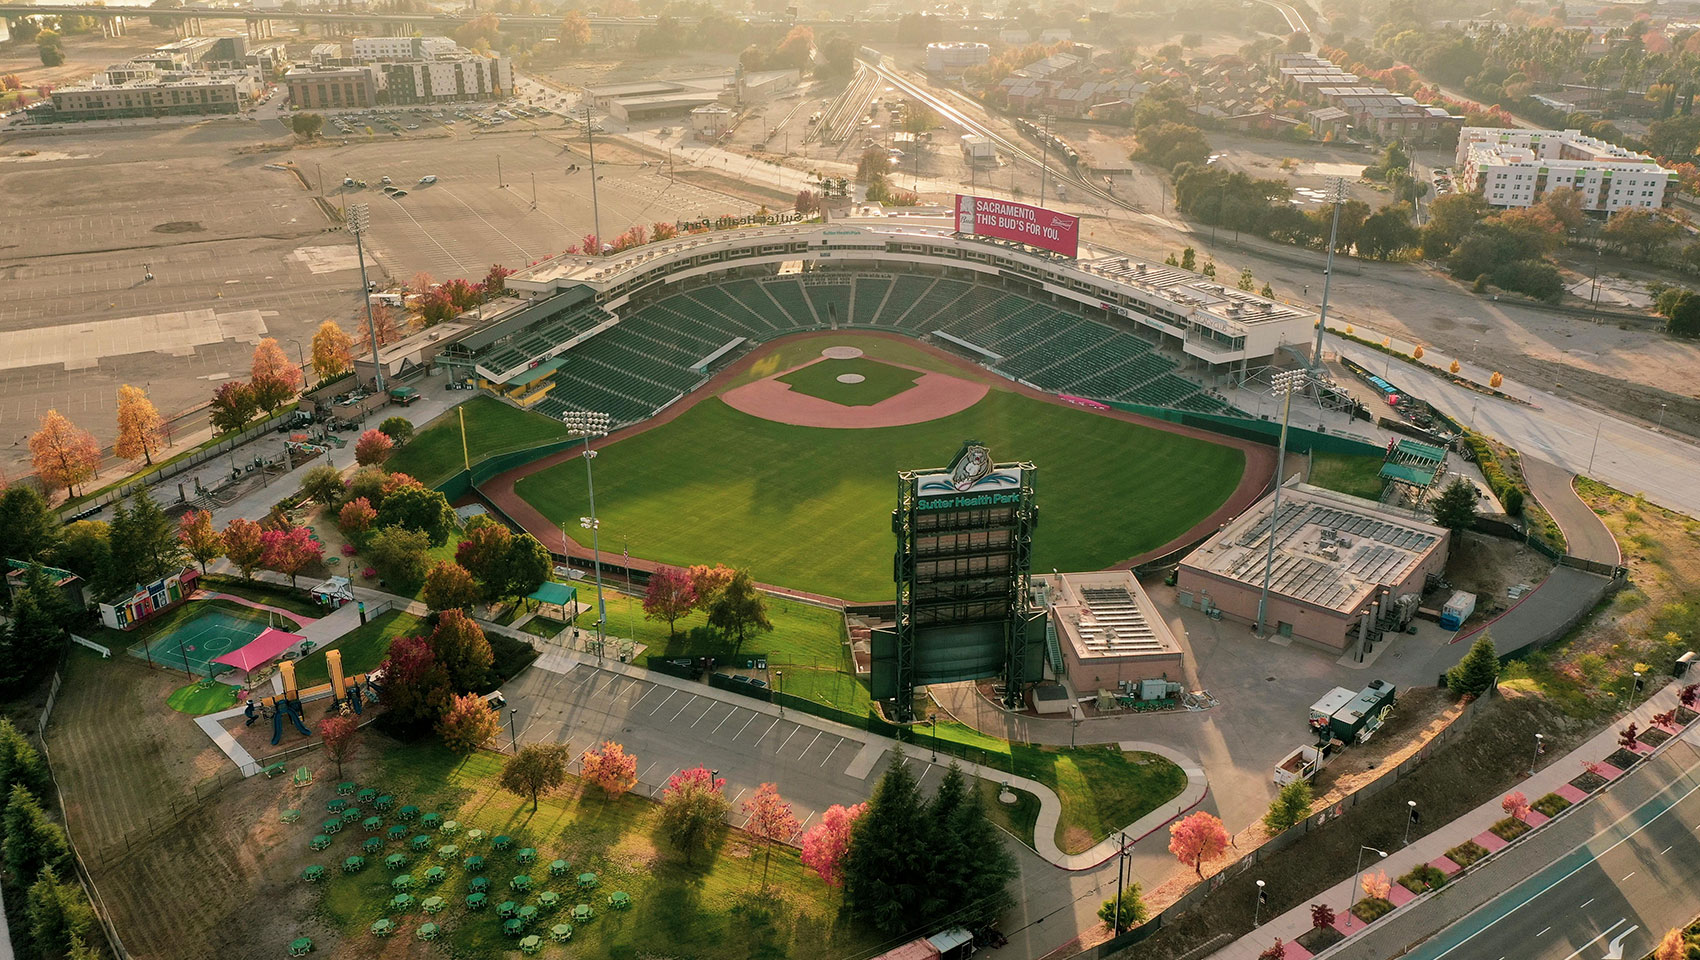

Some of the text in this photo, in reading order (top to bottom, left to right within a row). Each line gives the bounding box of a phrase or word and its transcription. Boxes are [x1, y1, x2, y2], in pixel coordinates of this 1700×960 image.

[976, 201, 1037, 223] SACRAMENTO,
[976, 213, 996, 227] THIS
[998, 217, 1024, 232] BUD'S
[1025, 223, 1041, 236] FOR
[1042, 227, 1060, 241] YOU.
[918, 493, 1019, 510] Sutter Health Park
